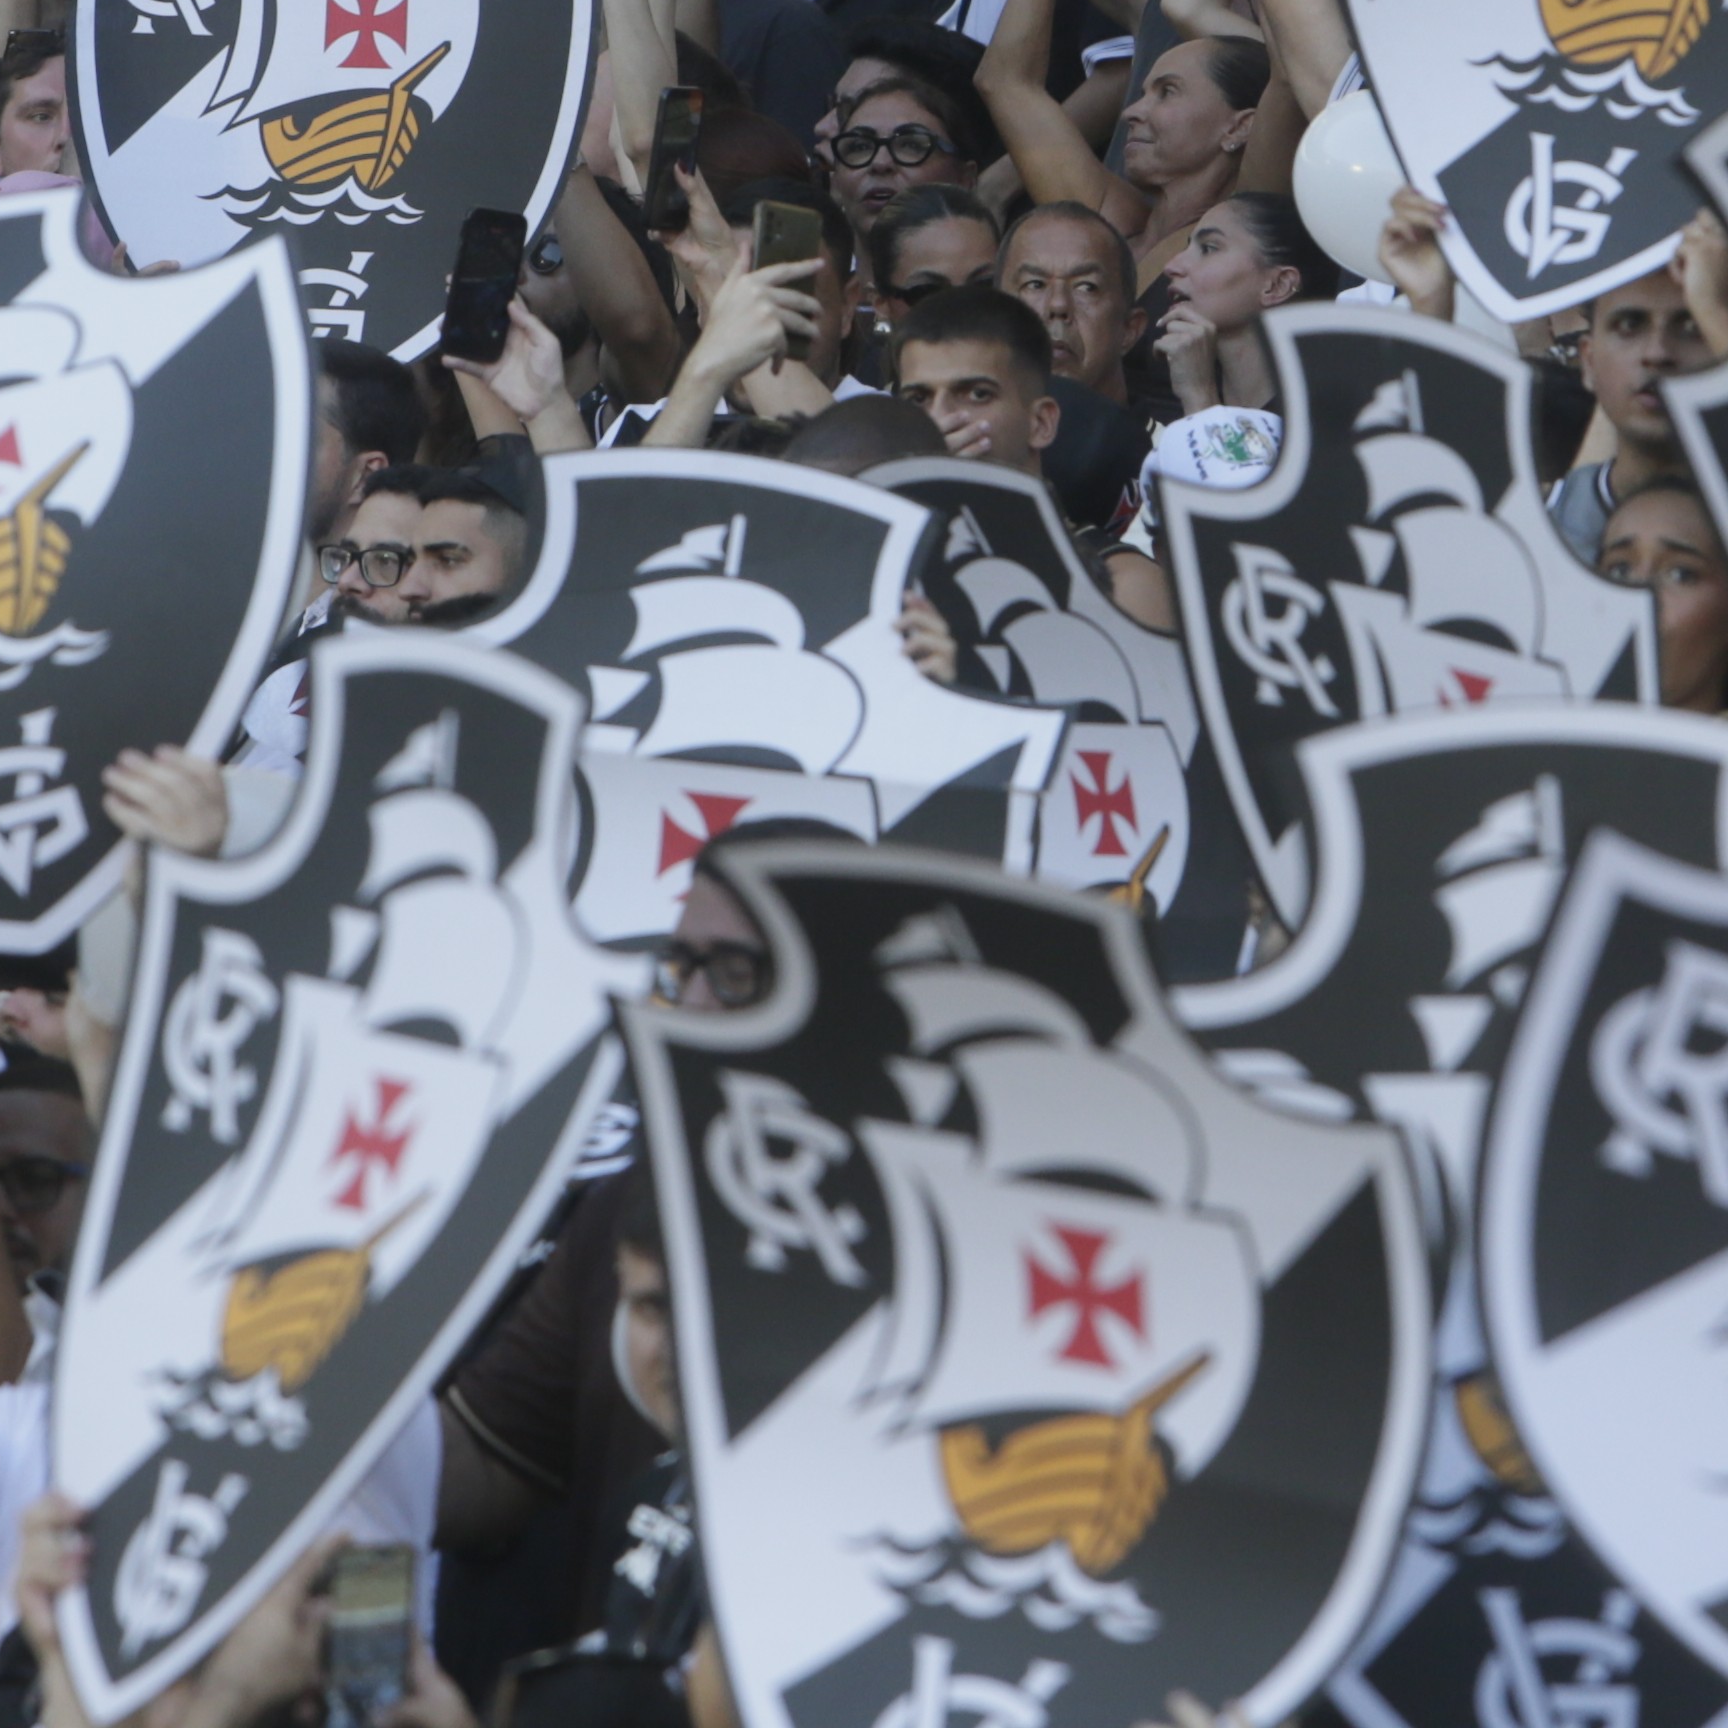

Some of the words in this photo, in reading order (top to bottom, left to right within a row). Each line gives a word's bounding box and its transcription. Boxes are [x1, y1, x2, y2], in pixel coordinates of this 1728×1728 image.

[1503, 131, 1639, 280] VG
[1221, 541, 1341, 717] CR
[161, 926, 278, 1144] CR
[703, 1068, 870, 1289] CR
